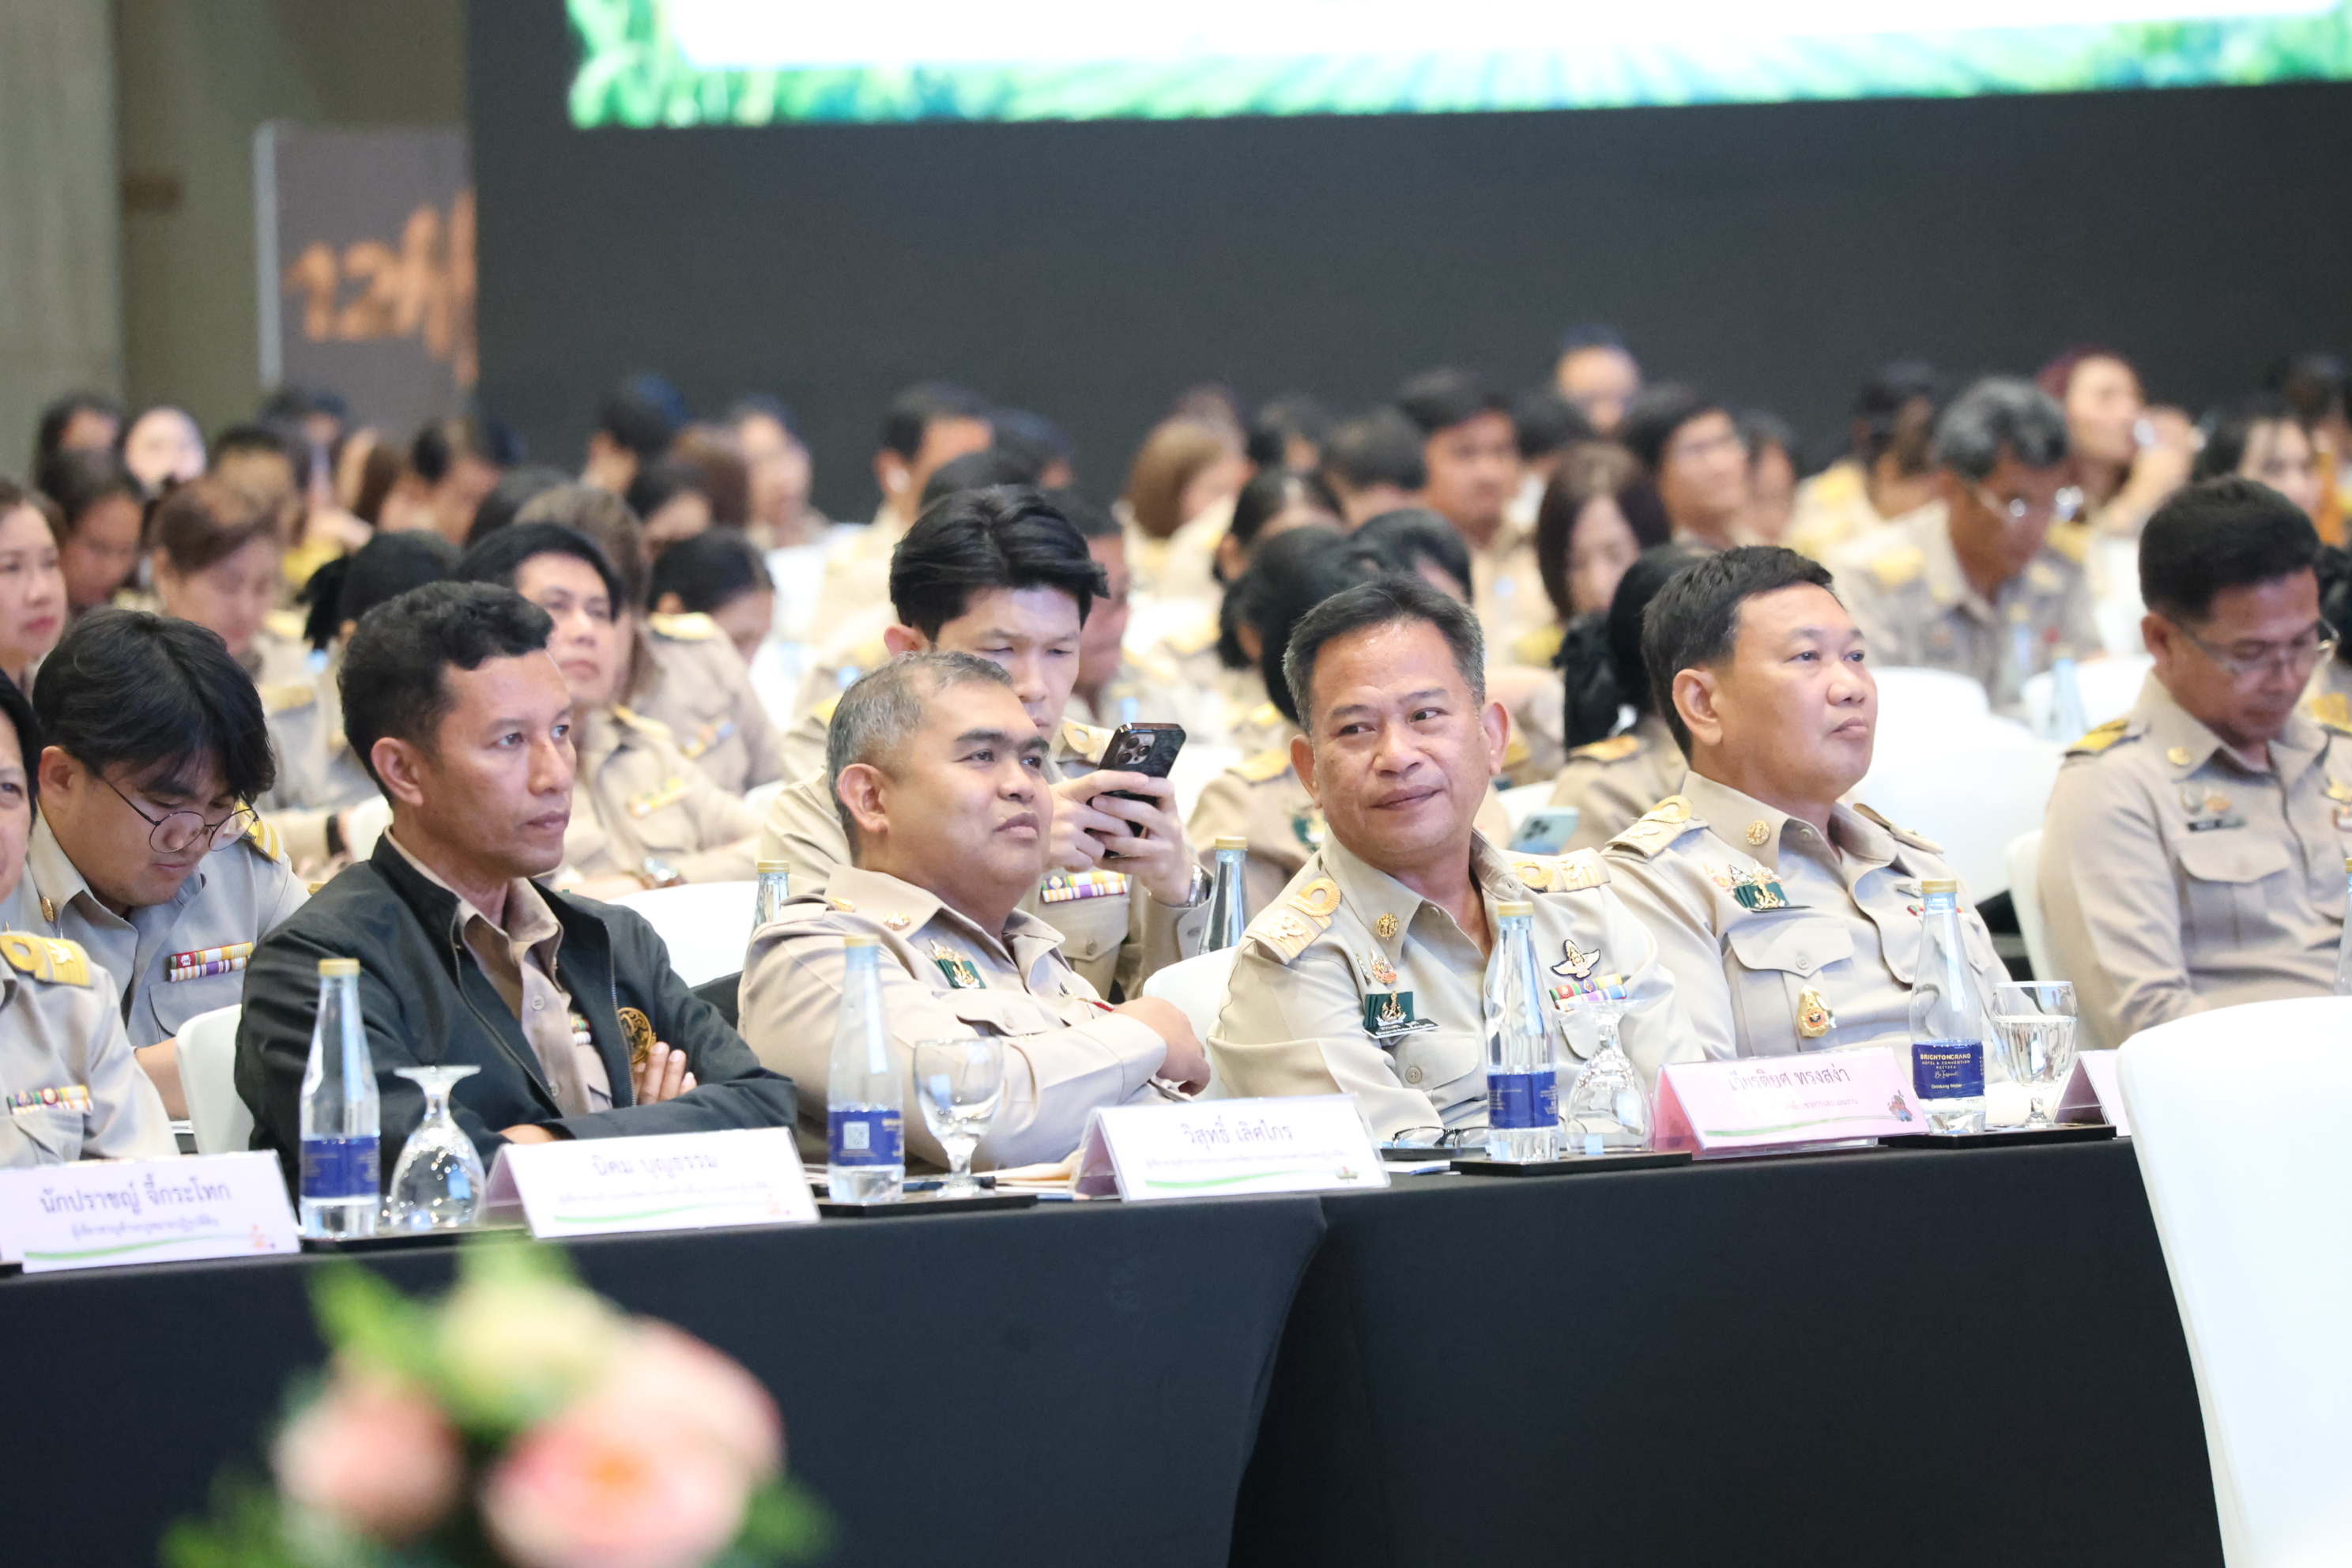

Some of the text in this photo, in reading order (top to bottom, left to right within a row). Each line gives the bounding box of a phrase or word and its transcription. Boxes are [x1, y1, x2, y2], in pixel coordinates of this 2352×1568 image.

[1794, 1063, 1851, 1086] ทรงสง่า
[1181, 1114, 1231, 1152] วิสุทธิ์
[40, 1180, 142, 1216] นักปราชญ์
